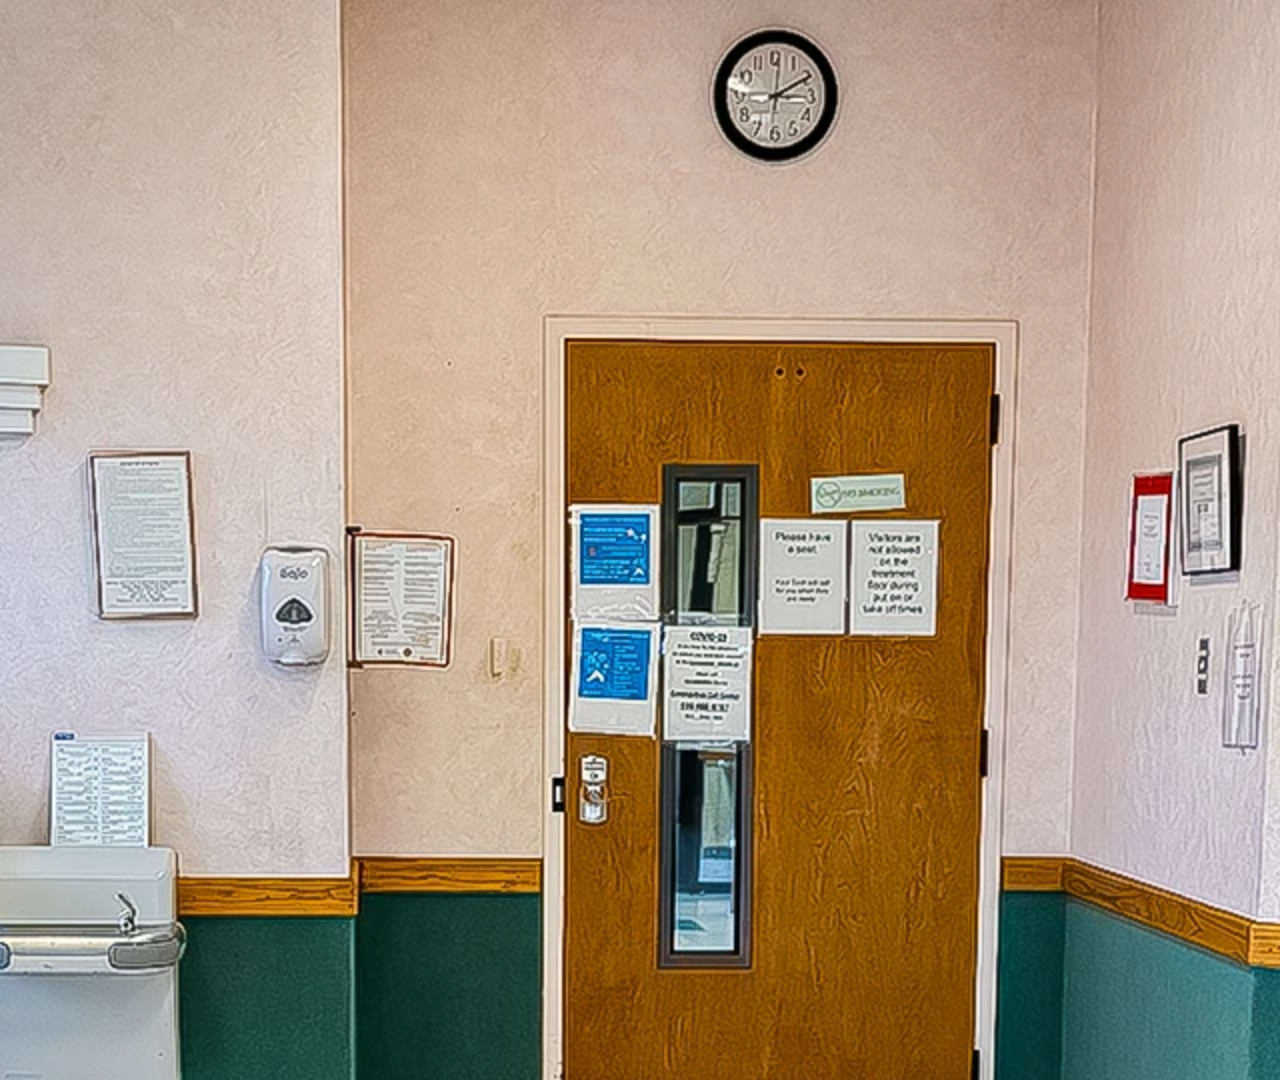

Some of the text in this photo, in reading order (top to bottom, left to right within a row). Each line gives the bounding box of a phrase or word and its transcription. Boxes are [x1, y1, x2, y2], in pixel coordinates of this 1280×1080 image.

[753, 55, 763, 71] 11
[807, 87, 816, 105] 3
[740, 106, 750, 122] 8
[800, 107, 811, 122] 4
[753, 120, 762, 136] 7
[770, 125, 781, 142] 6
[788, 120, 799, 137] 5
[776, 531, 831, 542] Please have
[868, 532, 921, 543] Visitors are
[787, 545, 795, 553] a
[868, 544, 921, 555] not allowed
[880, 557, 908, 567] on the
[871, 569, 916, 578] treatment
[867, 580, 919, 592] floor during
[862, 605, 883, 613] take
